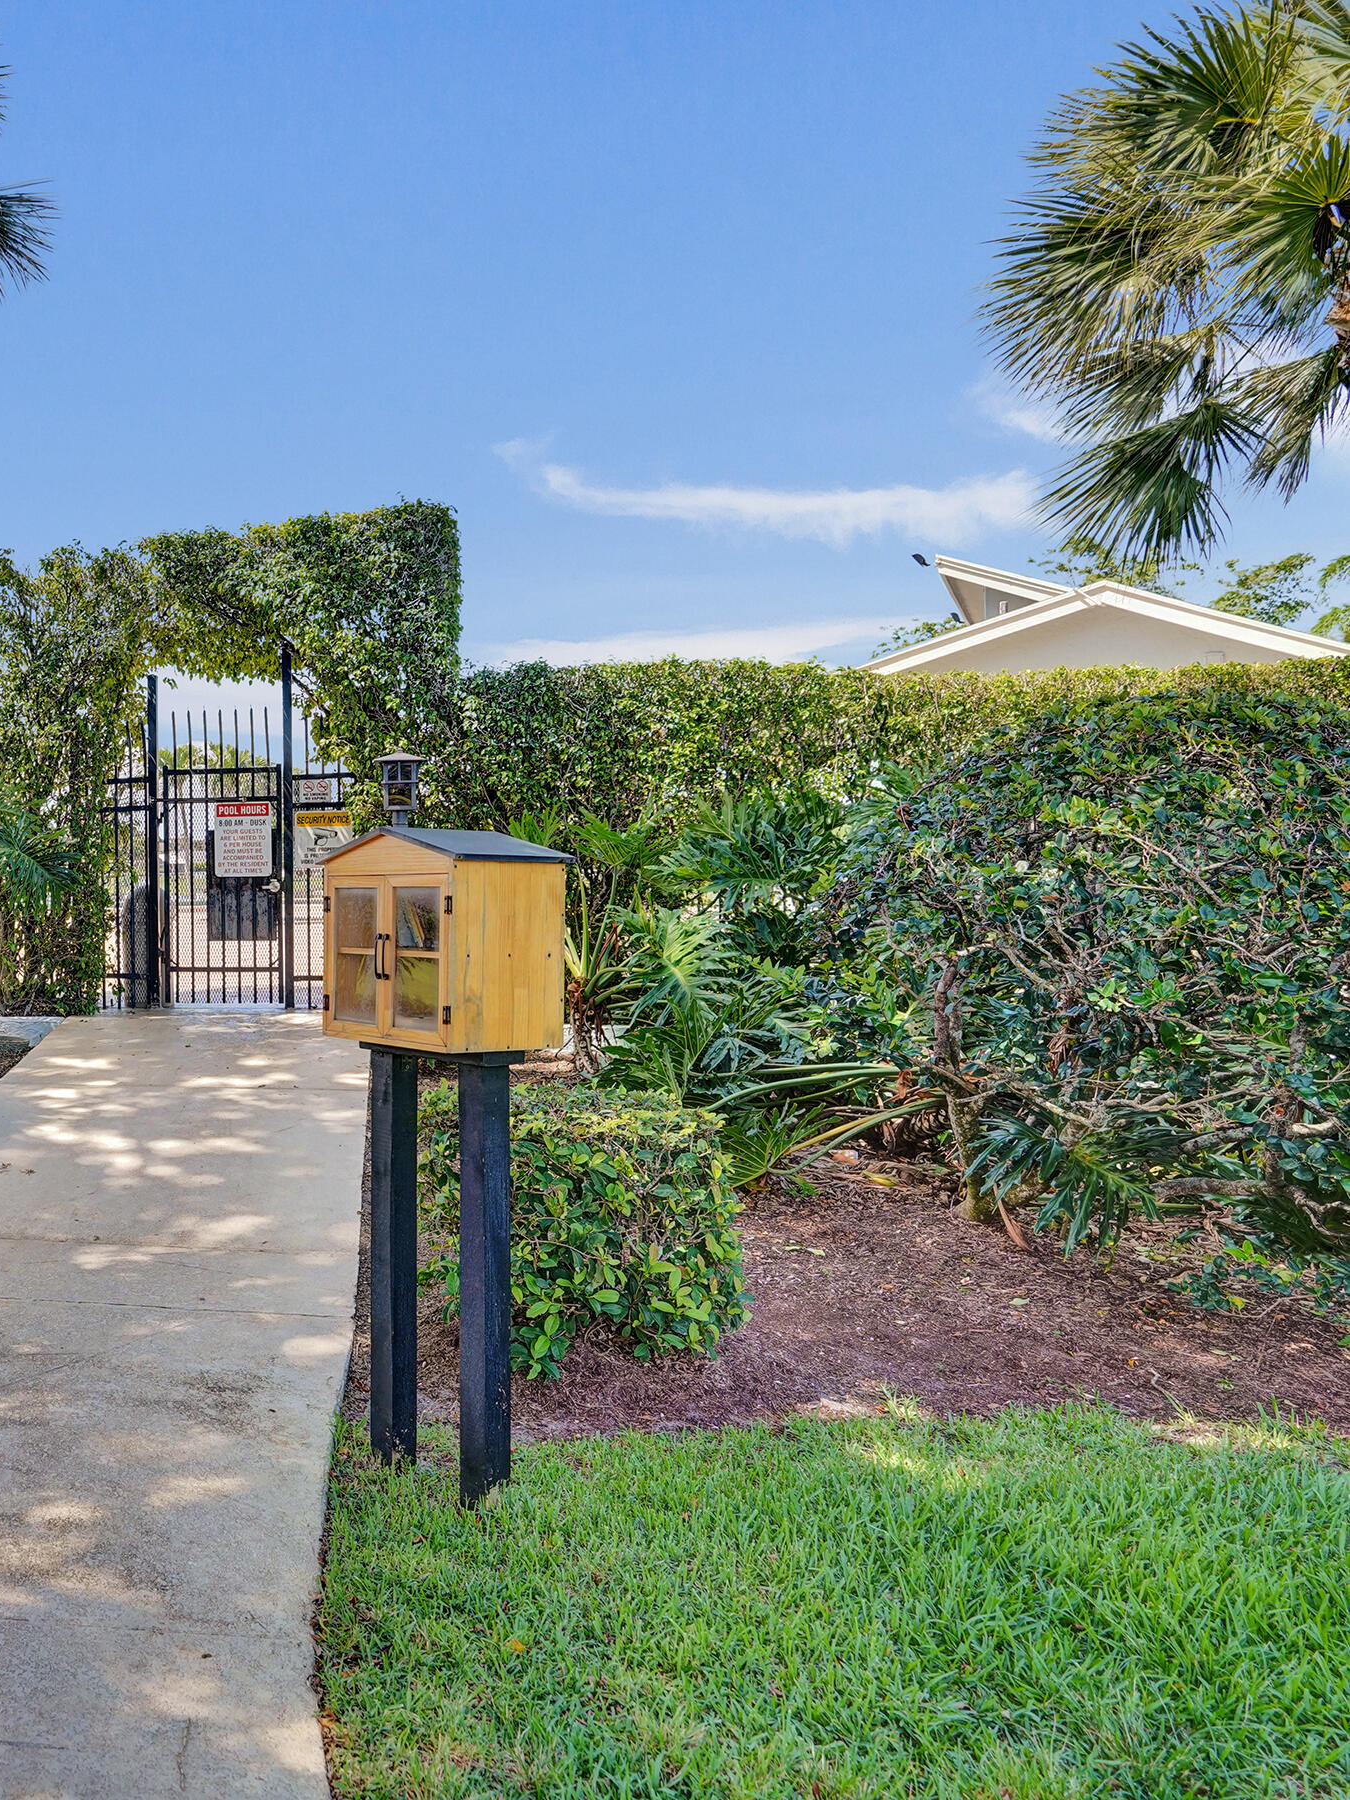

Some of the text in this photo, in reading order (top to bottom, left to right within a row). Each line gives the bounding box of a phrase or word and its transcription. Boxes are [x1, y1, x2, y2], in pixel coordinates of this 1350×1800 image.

[218, 806, 266, 815] POOL HOURS
[296, 815, 350, 824] SECURITY NOTICE
